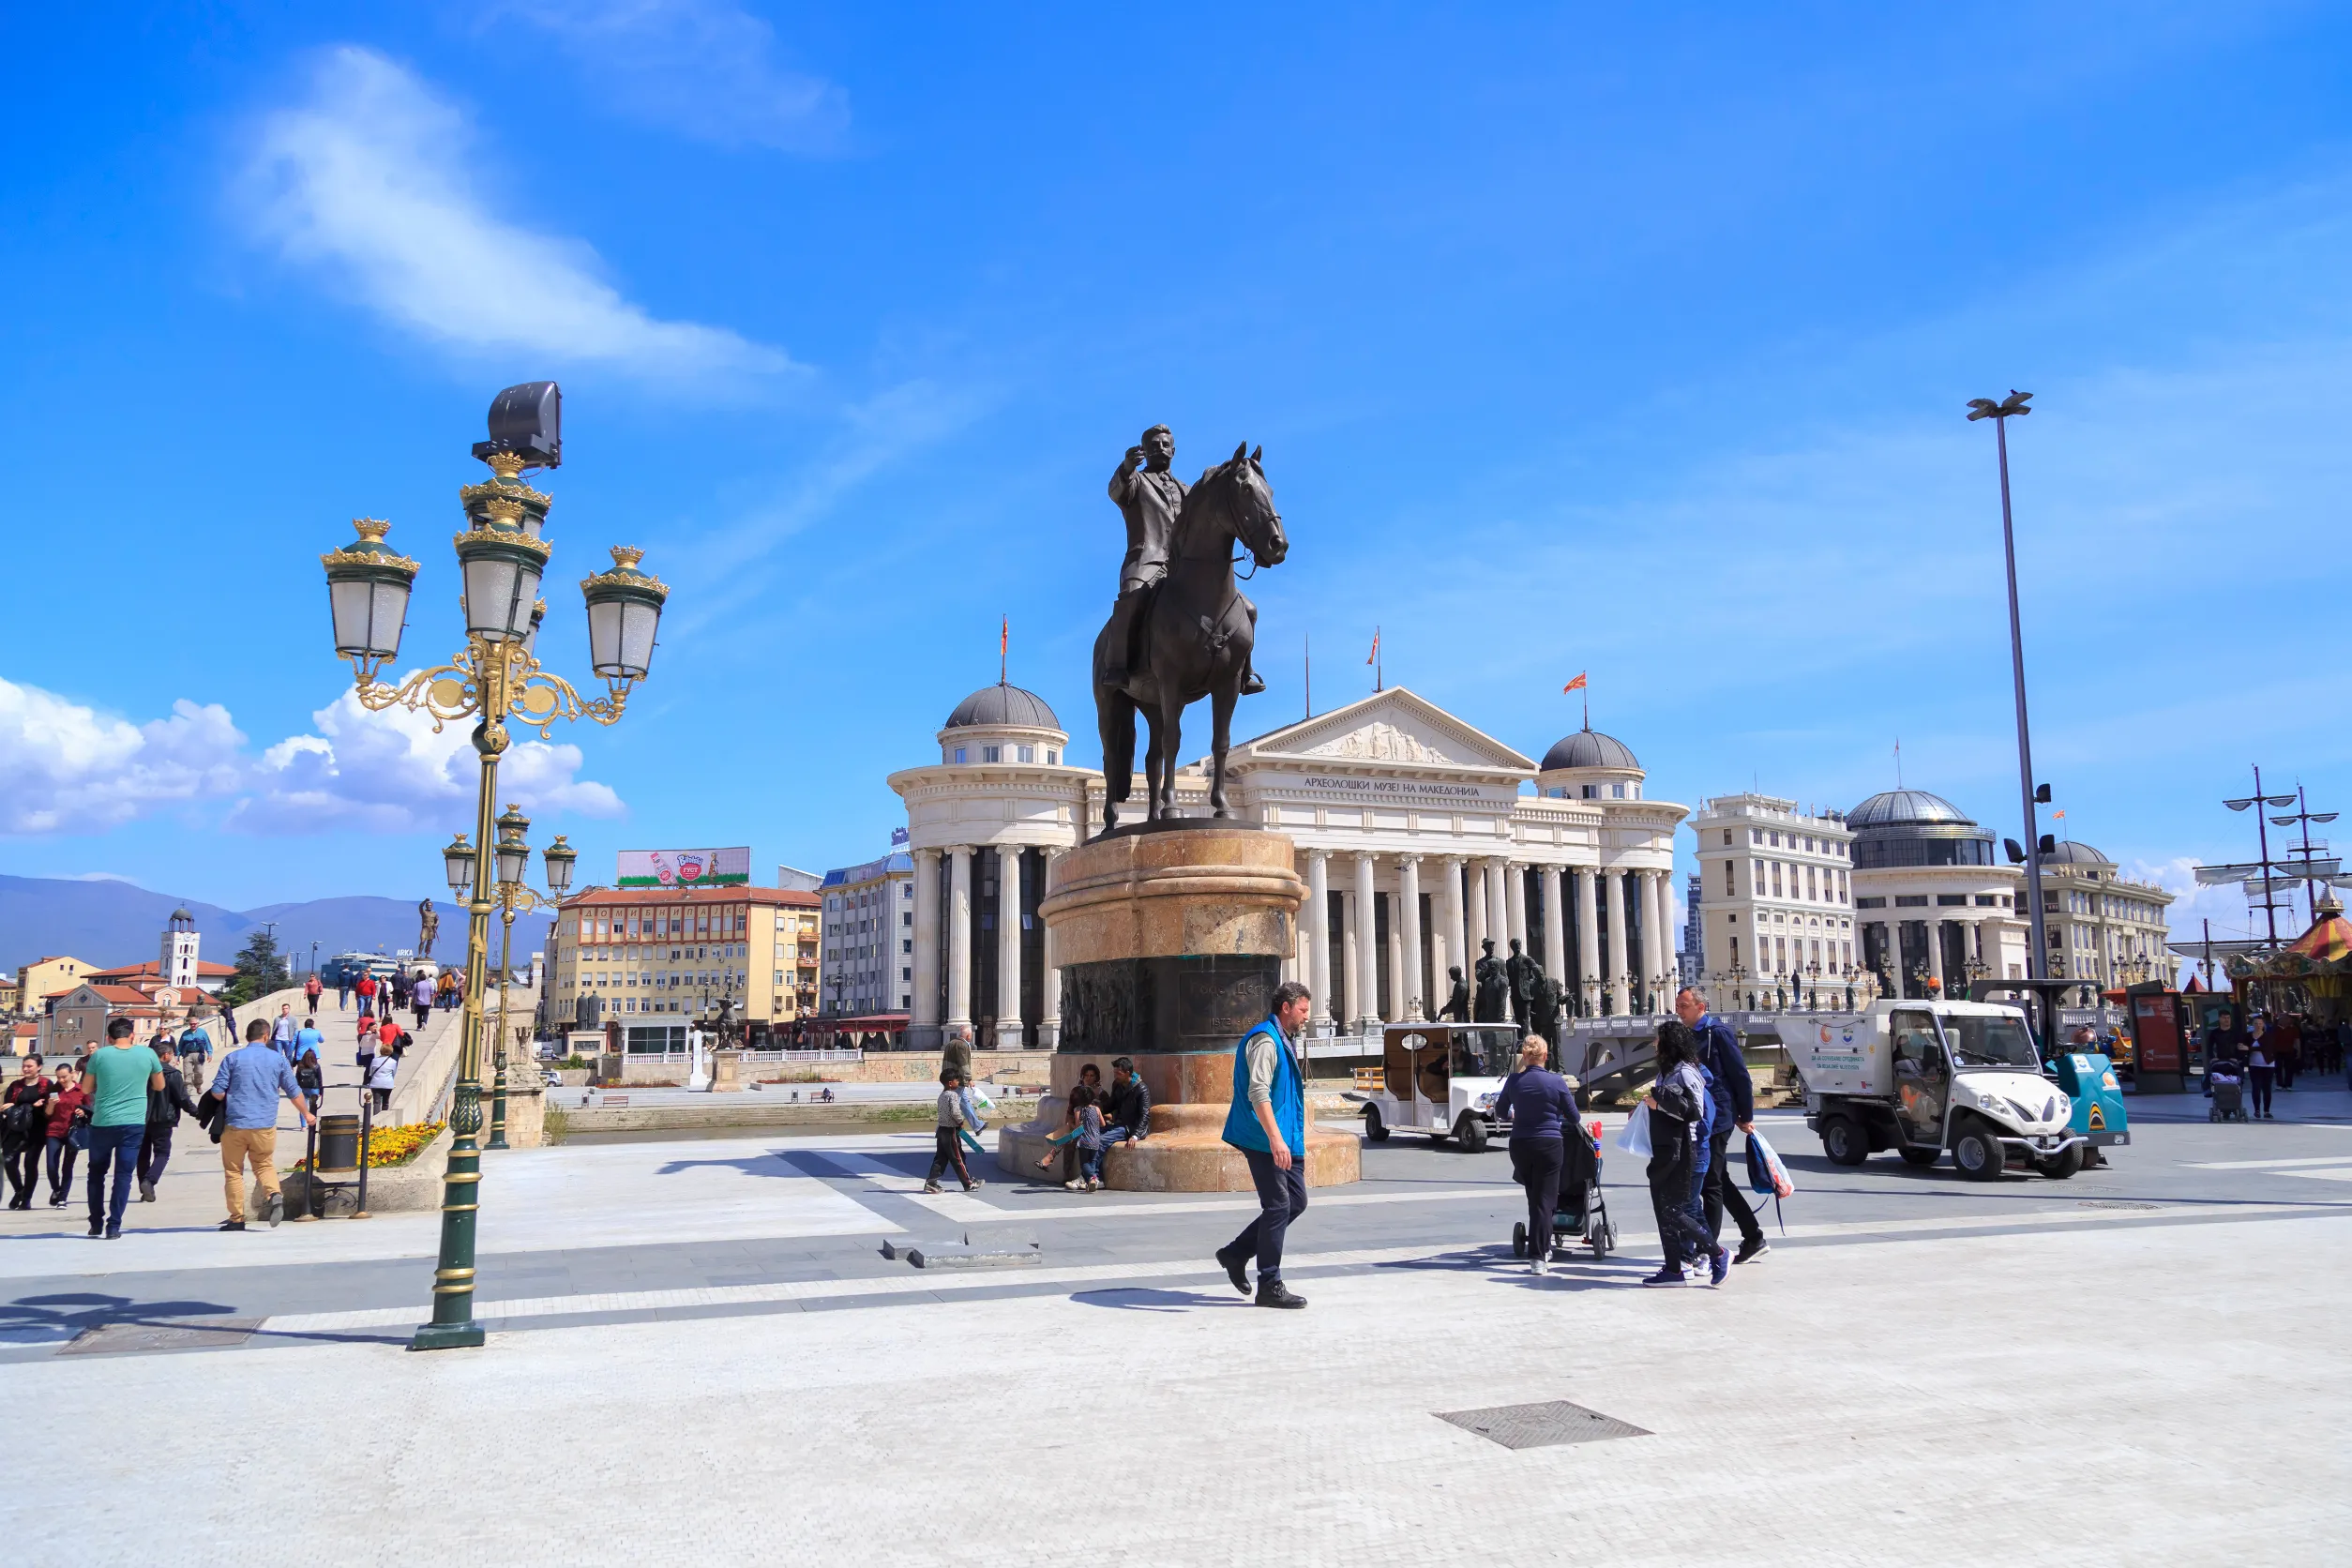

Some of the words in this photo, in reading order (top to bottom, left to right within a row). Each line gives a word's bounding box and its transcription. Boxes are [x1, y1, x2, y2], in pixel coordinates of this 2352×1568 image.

[1304, 777, 1370, 791] АРХЕОЛОШКИ
[1374, 781, 1400, 792] МУЗЕЈ
[1403, 784, 1416, 793] НА
[1419, 785, 1480, 797] МАКЕДОНИЈА
